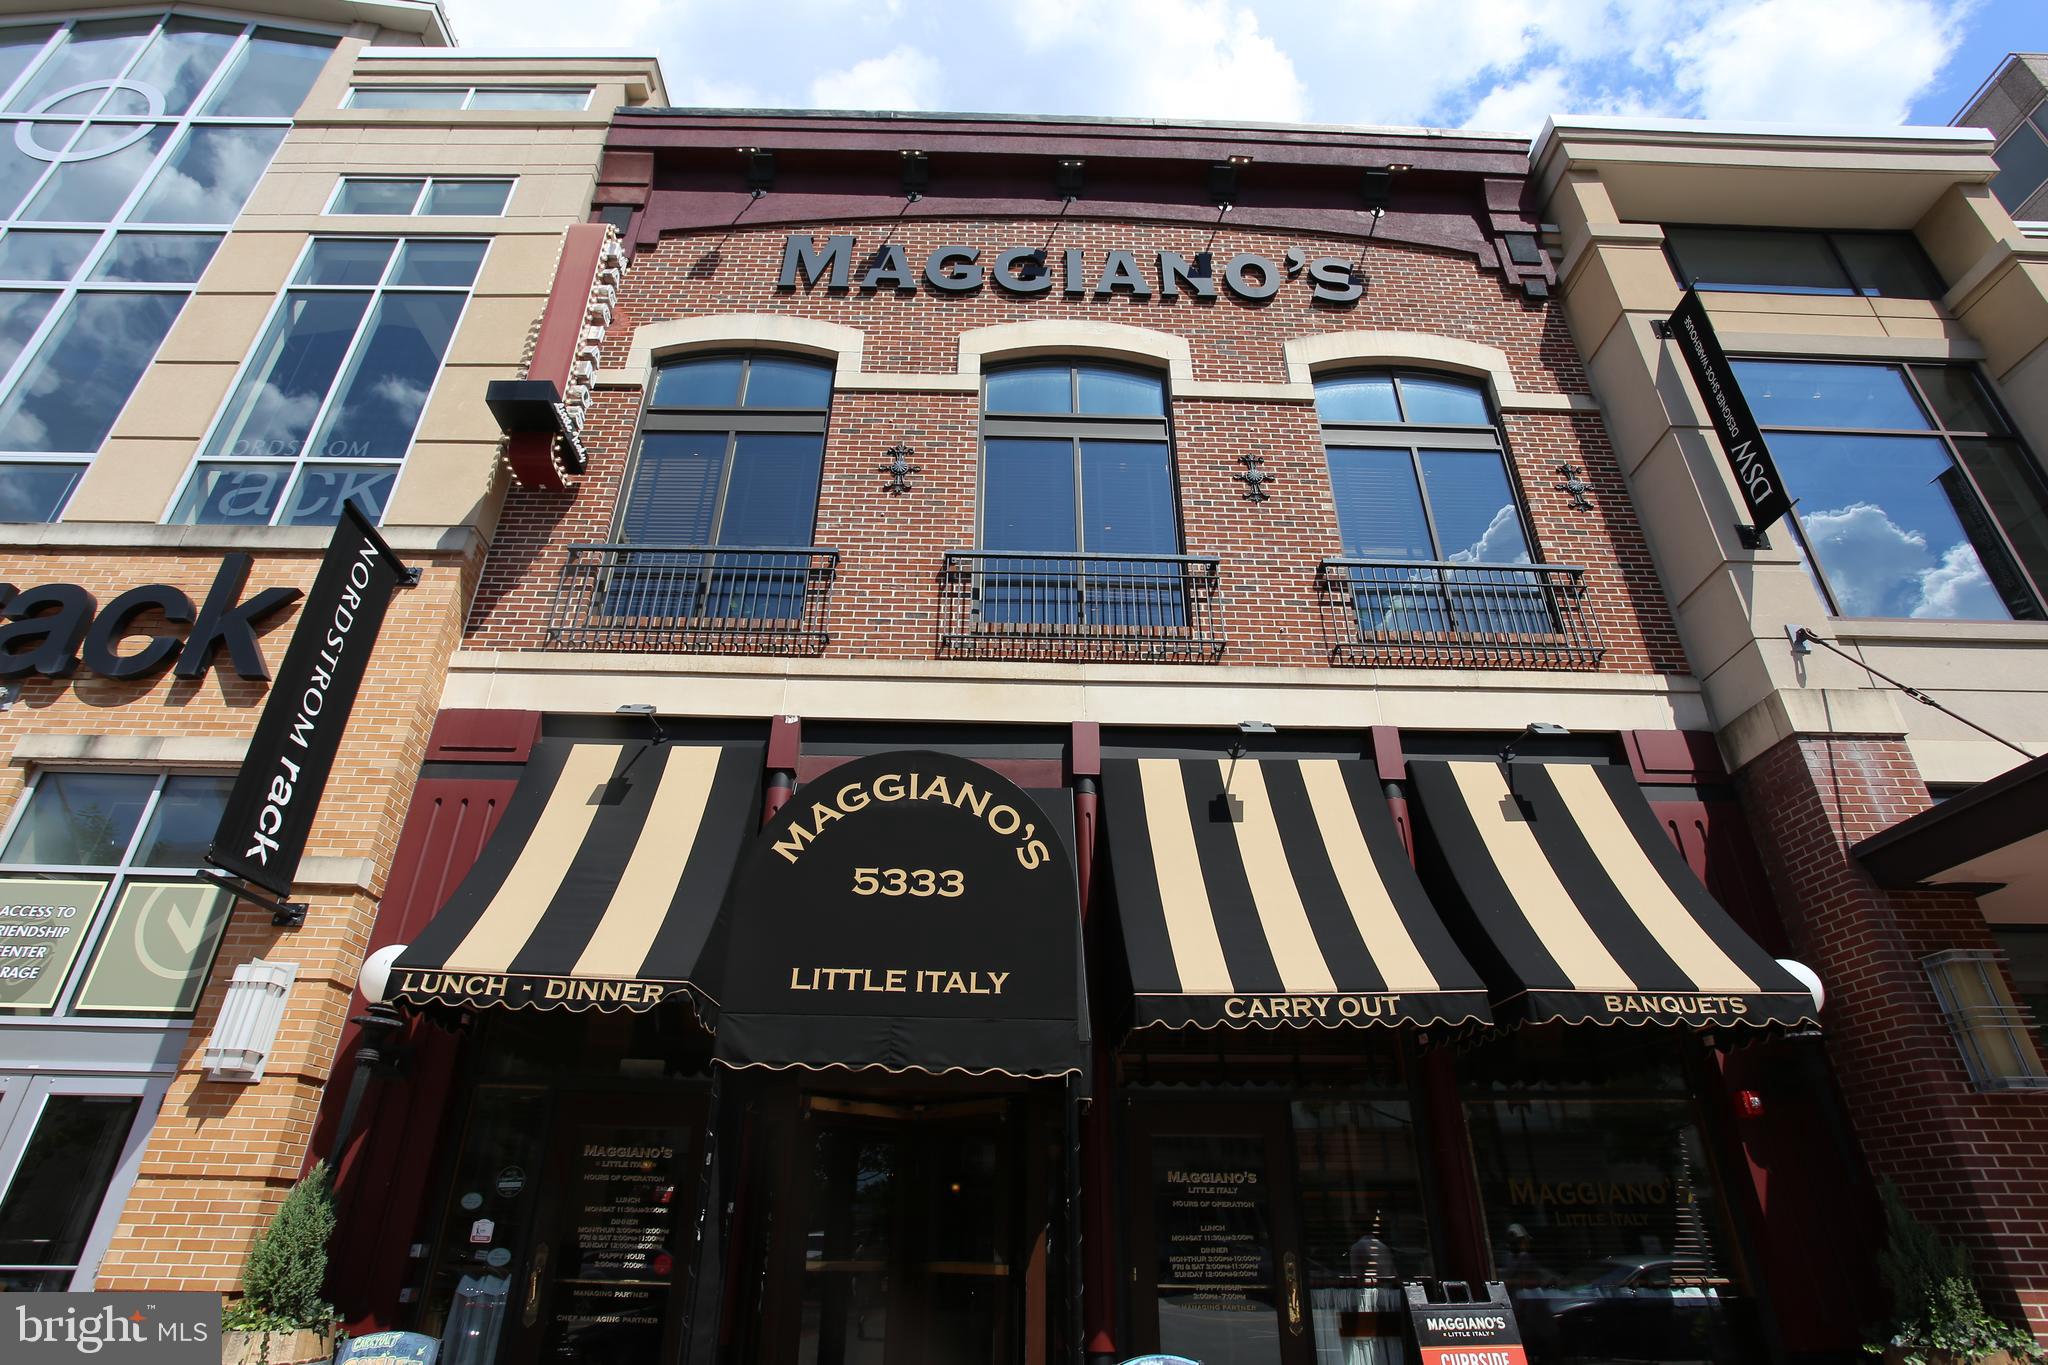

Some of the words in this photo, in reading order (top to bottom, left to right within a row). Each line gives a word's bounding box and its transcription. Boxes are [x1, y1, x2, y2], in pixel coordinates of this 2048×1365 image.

[776, 234, 1364, 305] MAGGIANO'S
[1683, 315, 1708, 369] WAREHOUSE
[1705, 366, 1721, 393] SHOE
[1715, 391, 1740, 438] DESIGNER
[1731, 440, 1773, 505] DSW
[208, 470, 400, 517] ack
[0, 552, 304, 682] ack
[289, 537, 380, 748] NORDSTROM
[245, 755, 300, 867] rack
[771, 773, 1050, 870] MAGGIANO'S
[852, 867, 965, 898] 5333
[0, 905, 54, 918] ACCESS
[57, 906, 77, 918] TO
[401, 972, 508, 997] LUNCH
[545, 979, 665, 1003] DINNER
[790, 967, 907, 992] LITTLE
[916, 970, 1010, 995] ITALY
[1224, 997, 1331, 1018] CARRY
[1338, 994, 1400, 1017] OUT
[1604, 994, 1748, 1015] BANQUETS
[583, 1144, 673, 1159] MAGGIANO'S
[1167, 1171, 1257, 1184] MAGGIANO'S
[1507, 1176, 1694, 1205] MAGGIANO'
[1172, 1200, 1198, 1208] HOURS
[1426, 1316, 1506, 1331] MAGGIANO'S
